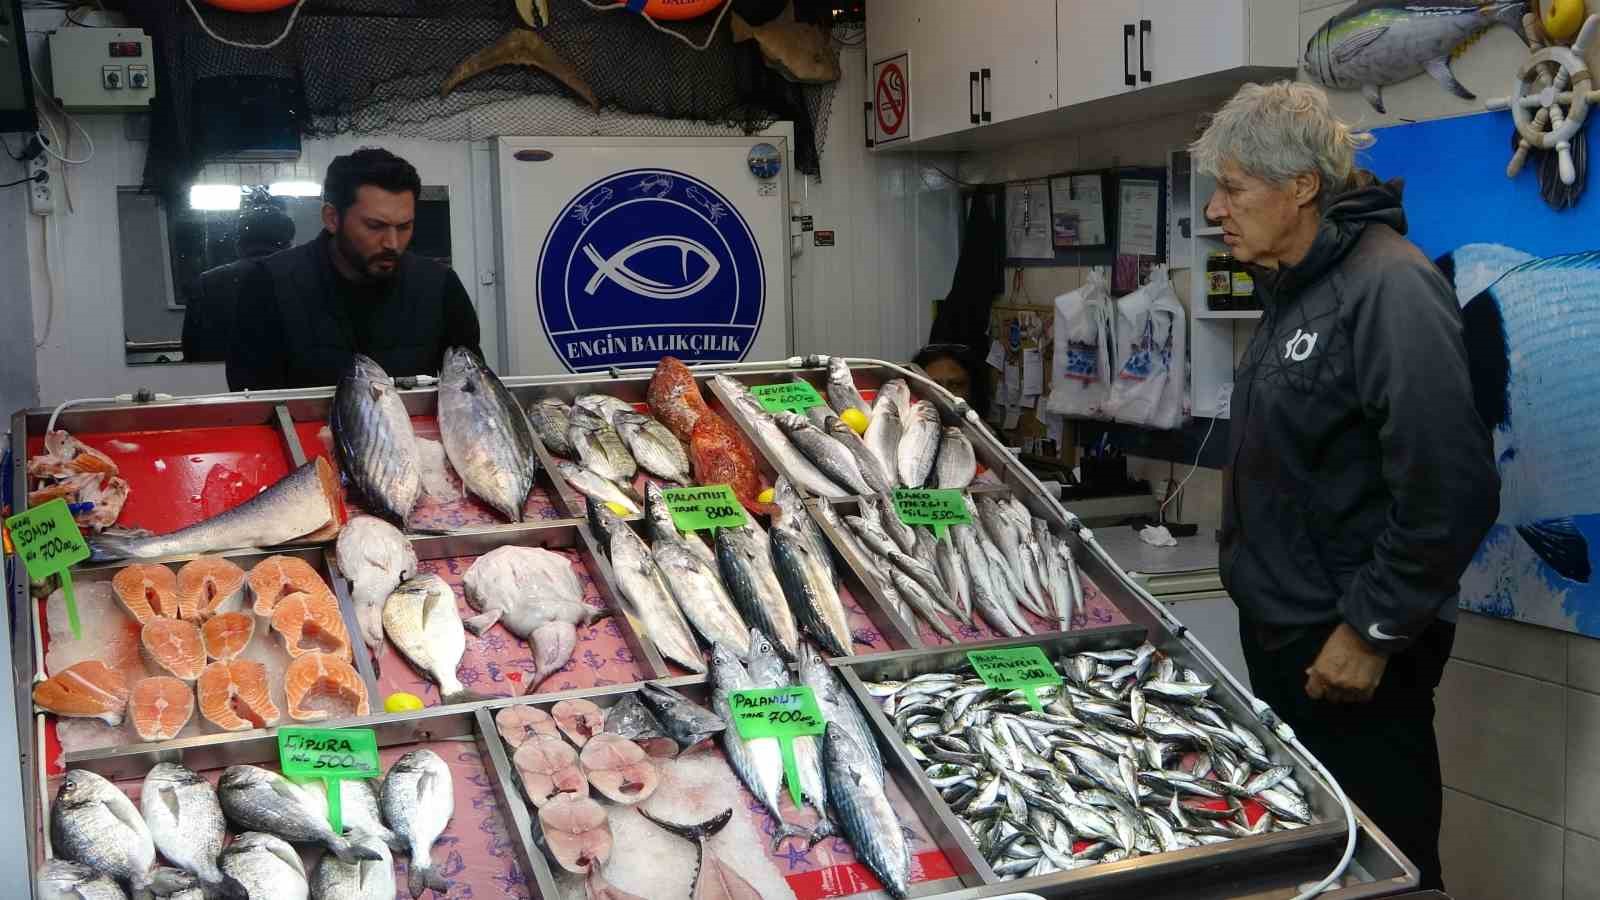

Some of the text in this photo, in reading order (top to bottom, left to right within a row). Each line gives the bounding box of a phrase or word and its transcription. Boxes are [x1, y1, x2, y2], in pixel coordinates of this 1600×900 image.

[567, 333, 741, 359] ENGİN BALIKÇILIK
[666, 490, 728, 503] PALAMUT
[18, 518, 56, 547] SOMON
[733, 692, 804, 709] PALAMUT
